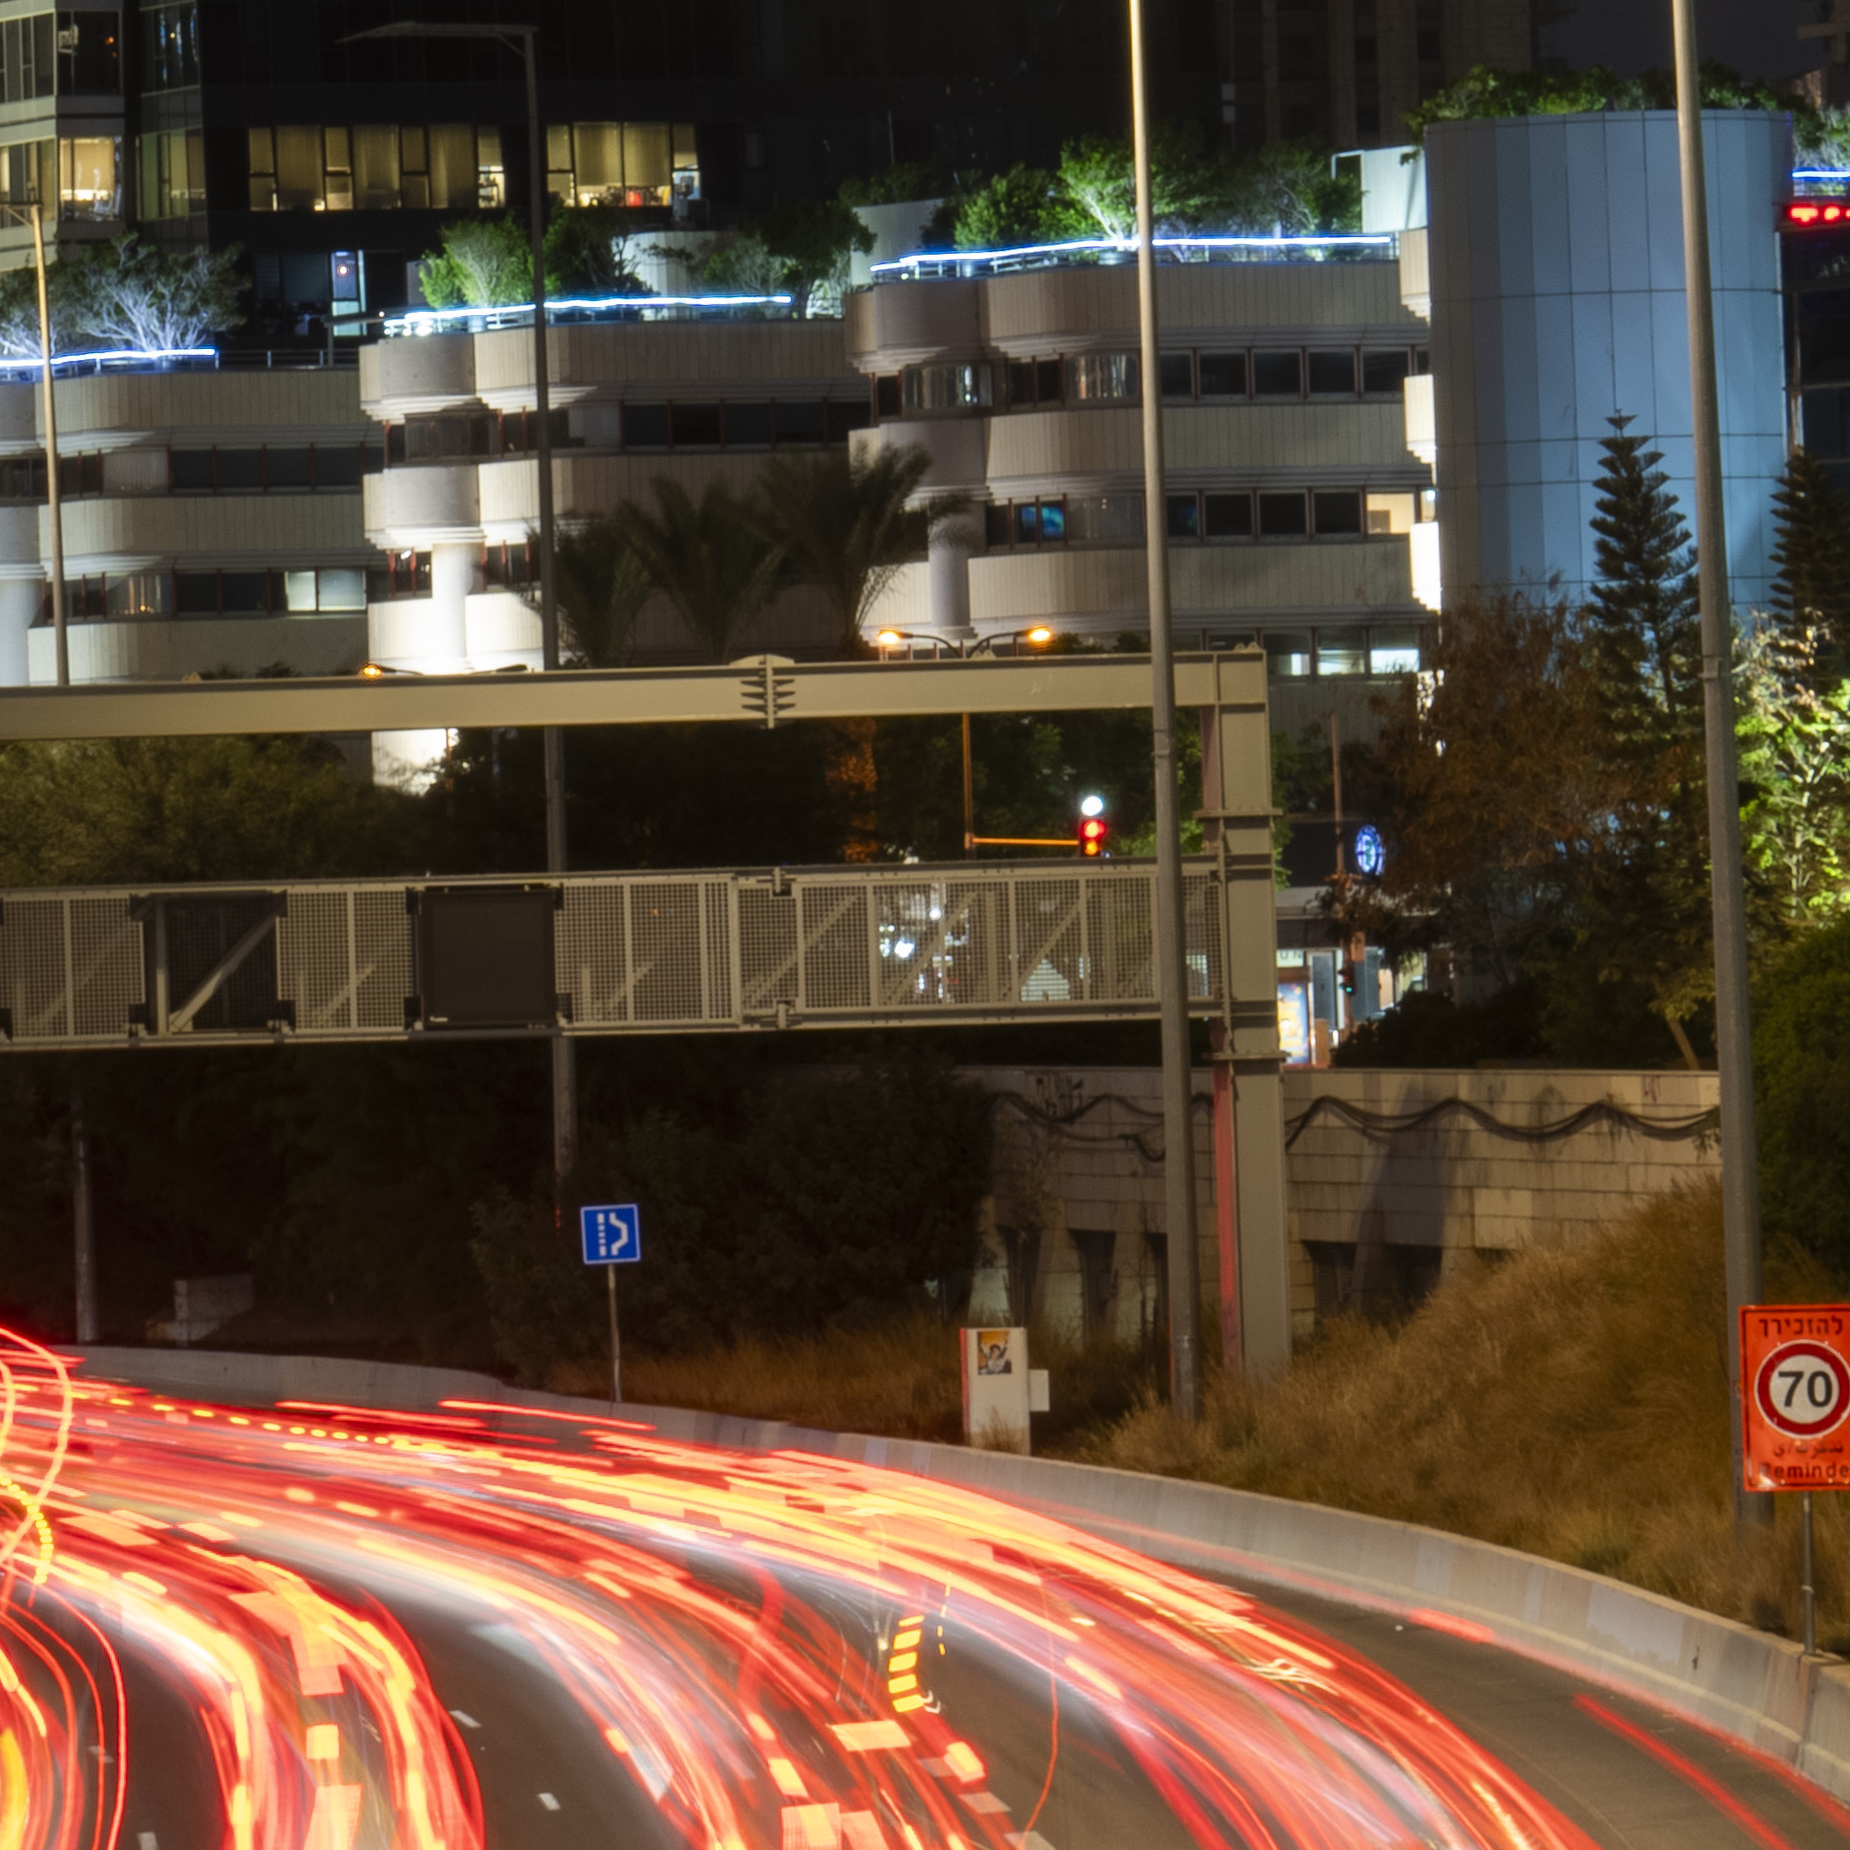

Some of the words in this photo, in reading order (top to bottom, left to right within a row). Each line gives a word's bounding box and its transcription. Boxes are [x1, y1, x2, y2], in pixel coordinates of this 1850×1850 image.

[1758, 1315, 1844, 1338] להזכירך
[1777, 1370, 1834, 1408] 70
[1758, 1461, 1850, 1480] Reminde
